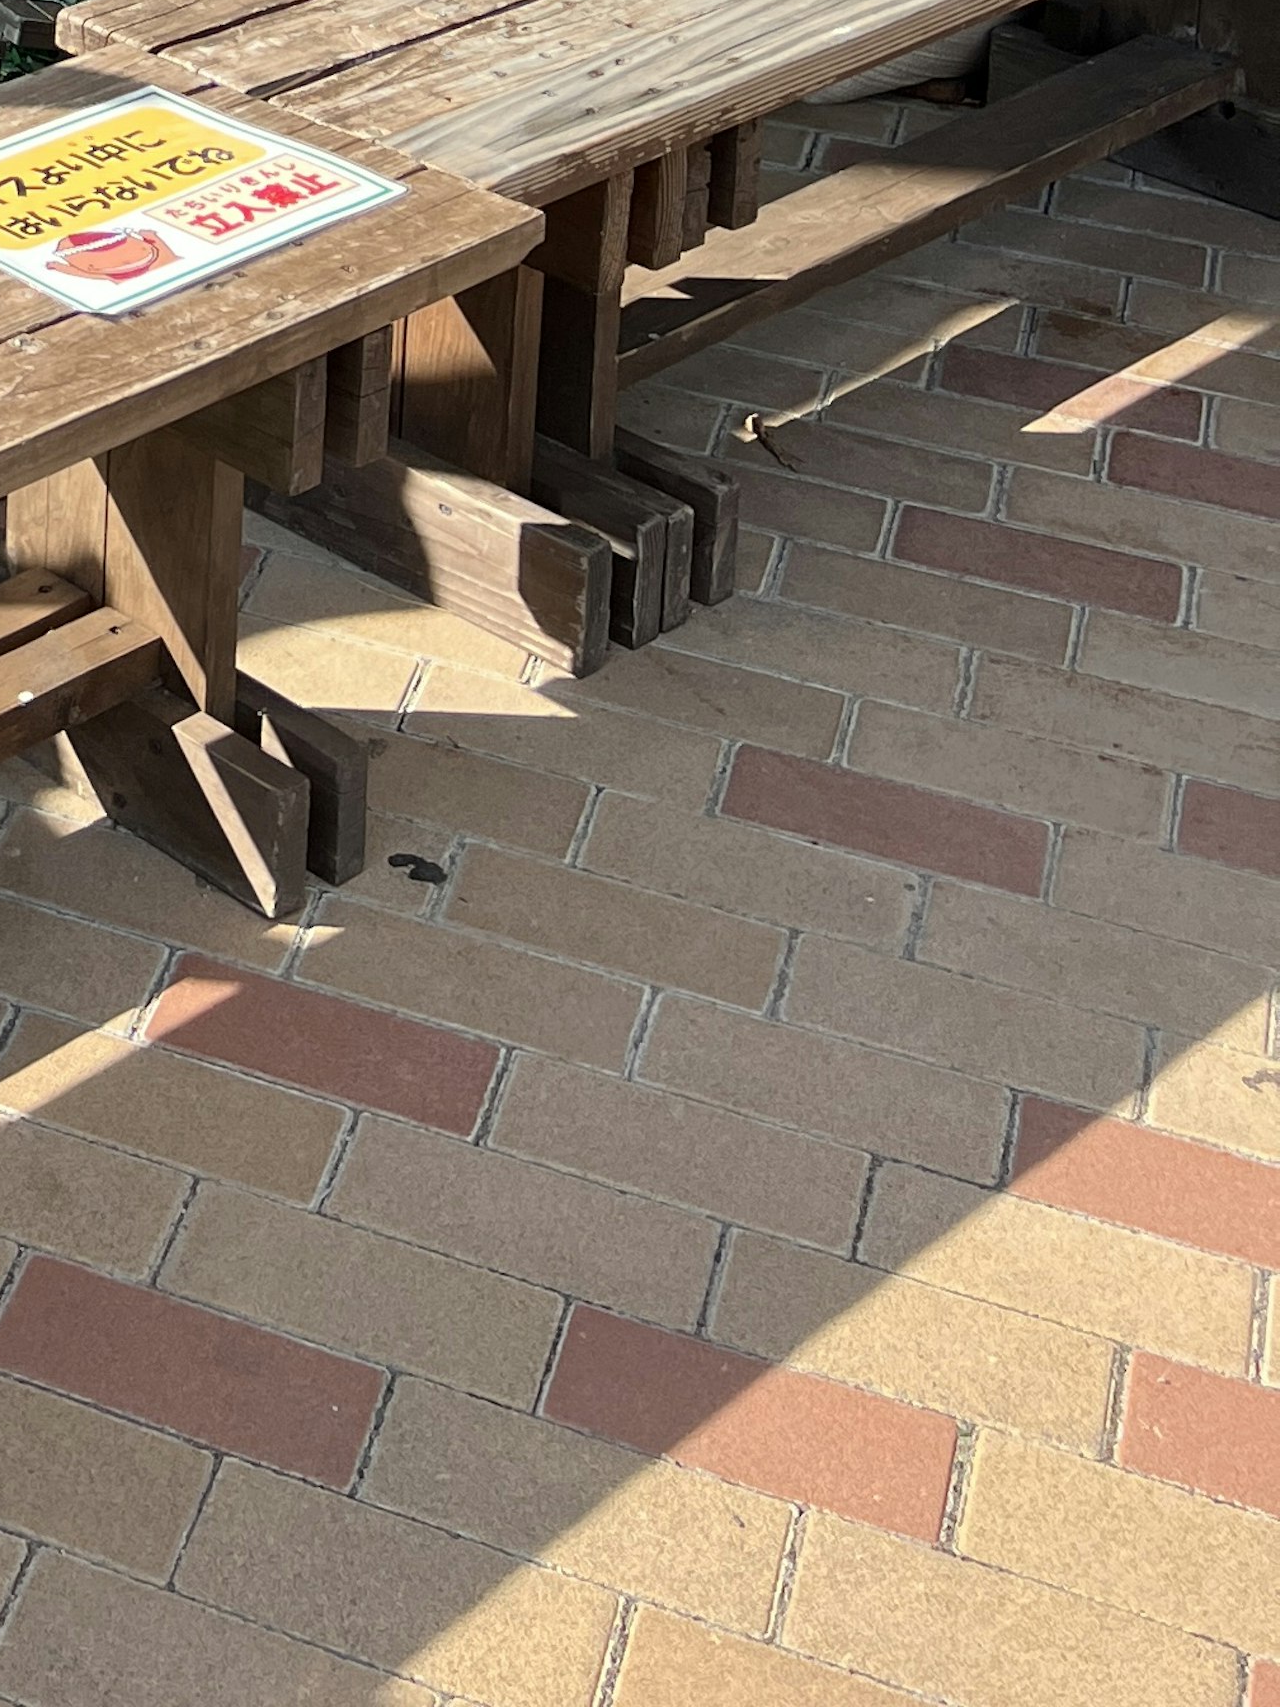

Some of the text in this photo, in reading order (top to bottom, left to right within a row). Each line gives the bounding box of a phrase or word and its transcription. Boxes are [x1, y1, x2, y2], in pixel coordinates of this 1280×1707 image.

[164, 162, 297, 219] たちいりきんし
[187, 172, 342, 237] 立入禁止
